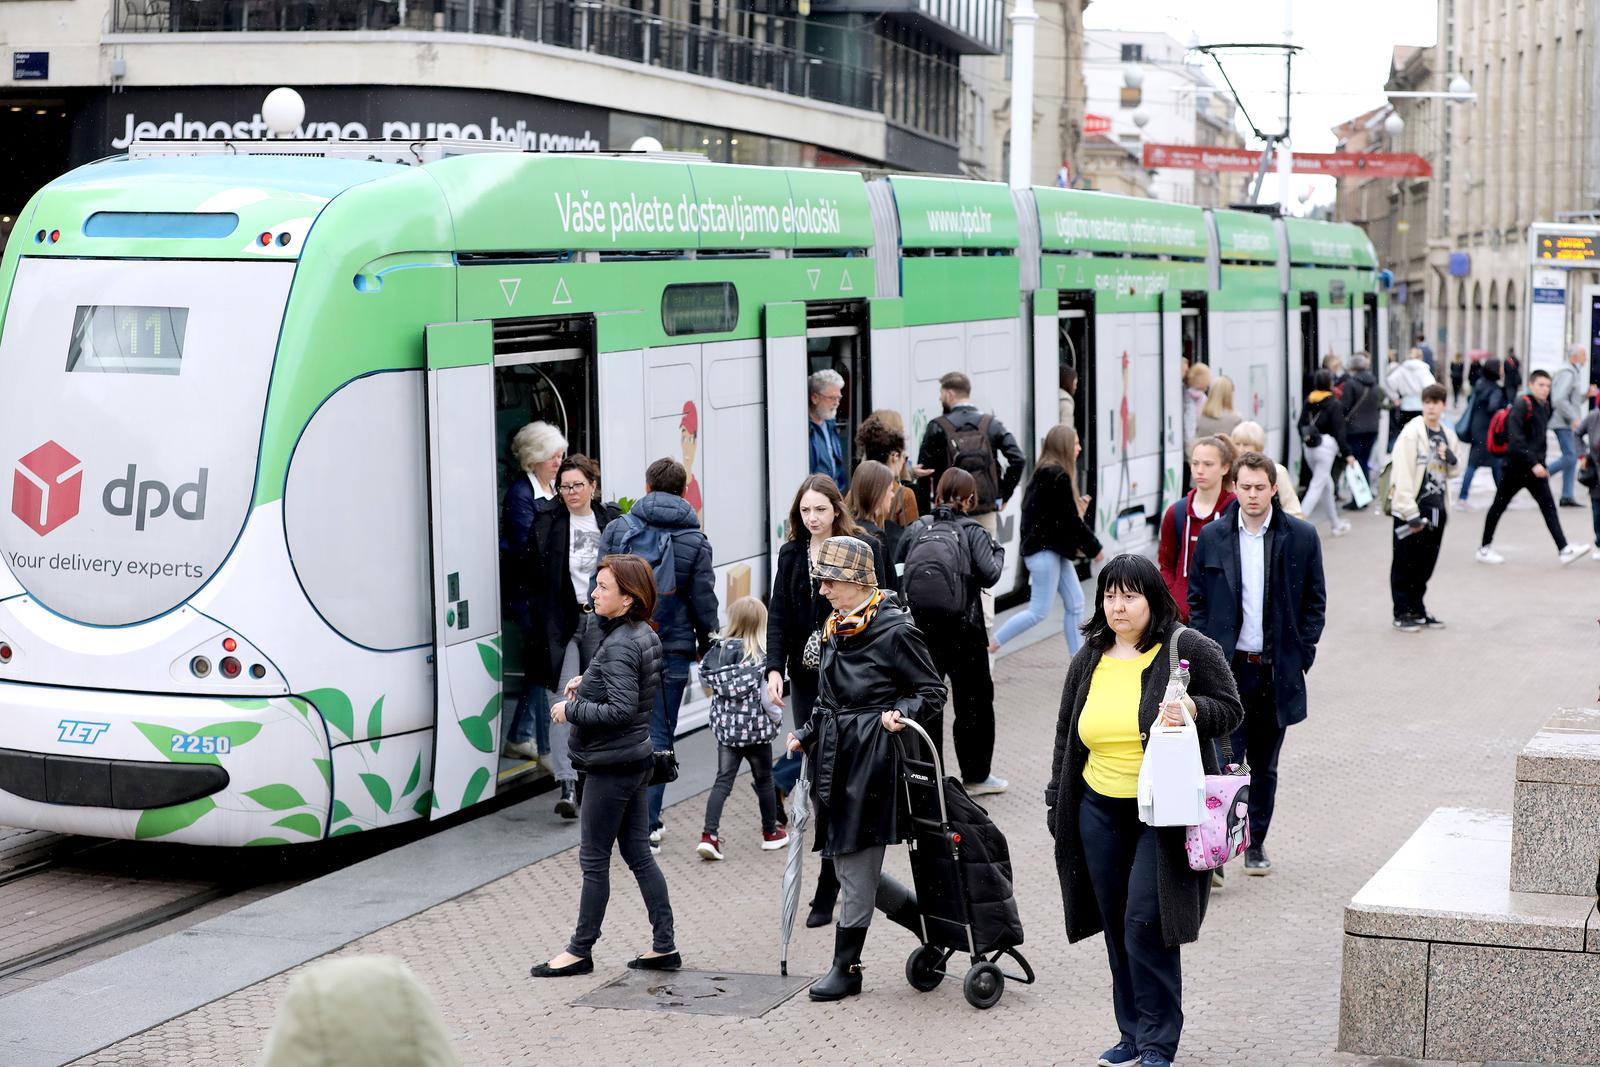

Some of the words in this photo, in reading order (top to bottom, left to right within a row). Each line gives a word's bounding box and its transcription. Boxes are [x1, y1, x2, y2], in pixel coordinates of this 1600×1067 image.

[111, 112, 368, 149] Jednostvno
[554, 189, 606, 232] Vaše
[608, 192, 674, 242] pakete
[677, 193, 780, 240] dostavljamo
[782, 197, 840, 233] ekološki
[926, 204, 992, 239] www.dpd.hr
[121, 312, 161, 354] 11
[102, 463, 209, 531] dpd
[8, 551, 46, 569] Your
[49, 553, 123, 577] delivery
[127, 561, 204, 579] experts
[57, 719, 111, 745] ZET
[171, 734, 231, 755] 2250
